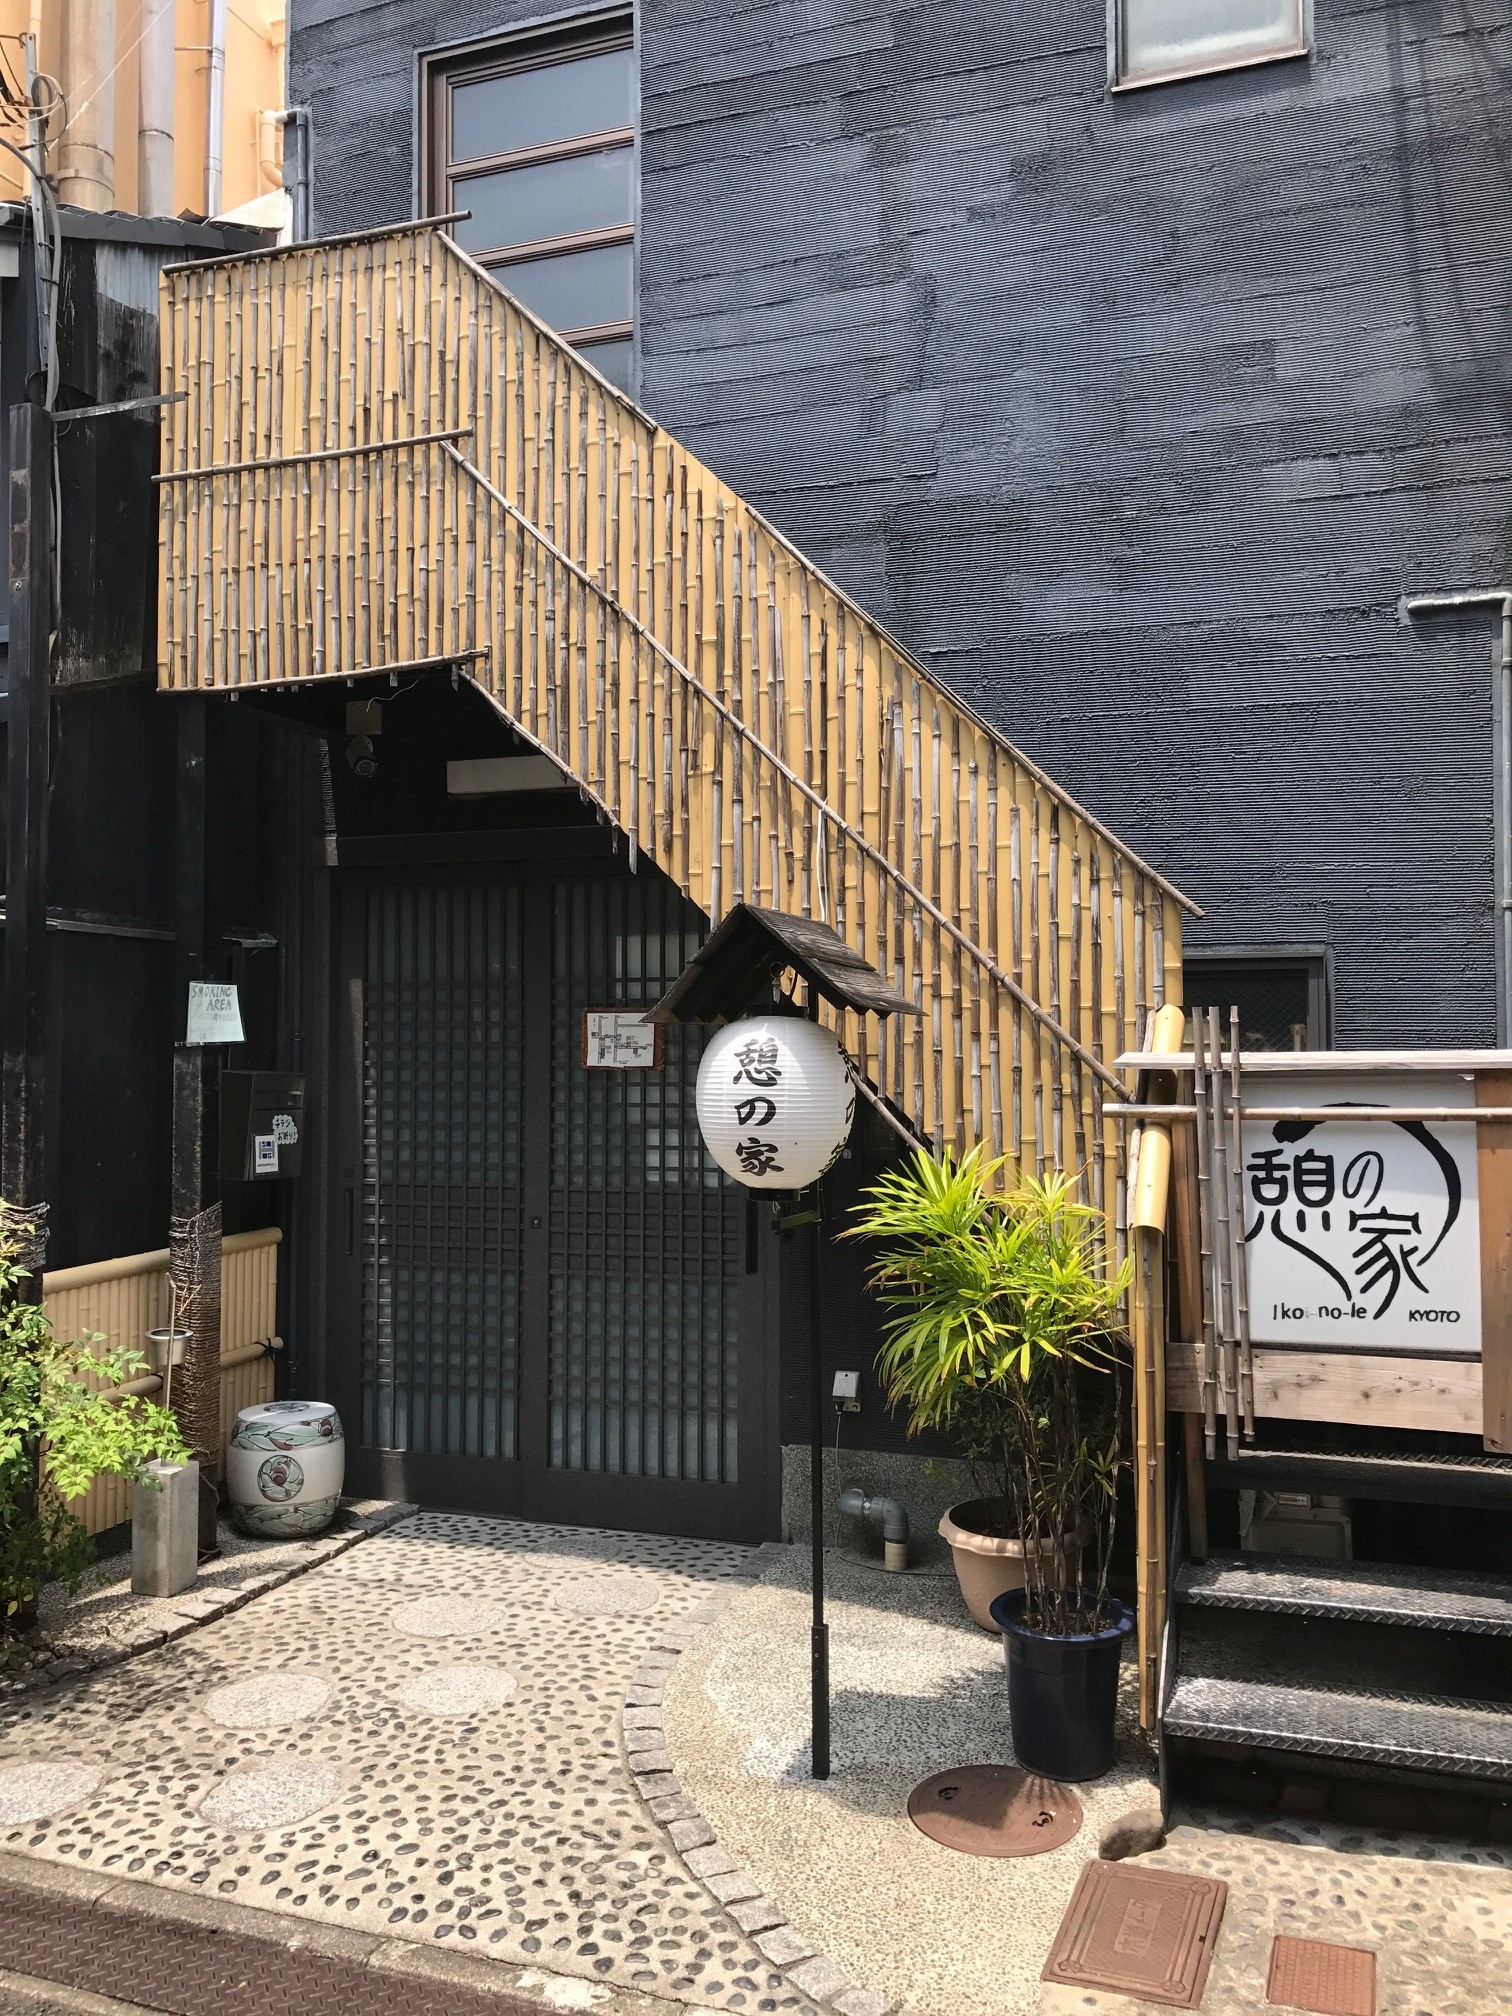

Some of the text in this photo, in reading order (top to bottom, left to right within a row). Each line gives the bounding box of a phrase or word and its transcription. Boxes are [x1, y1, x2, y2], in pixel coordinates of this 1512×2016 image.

[192, 985, 232, 998] SMOKING
[206, 999, 232, 1011] AREA
[732, 1037, 784, 1176] 憩の家
[275, 1119, 291, 1128] チラシ
[1409, 1309, 1460, 1322] KYOTO
